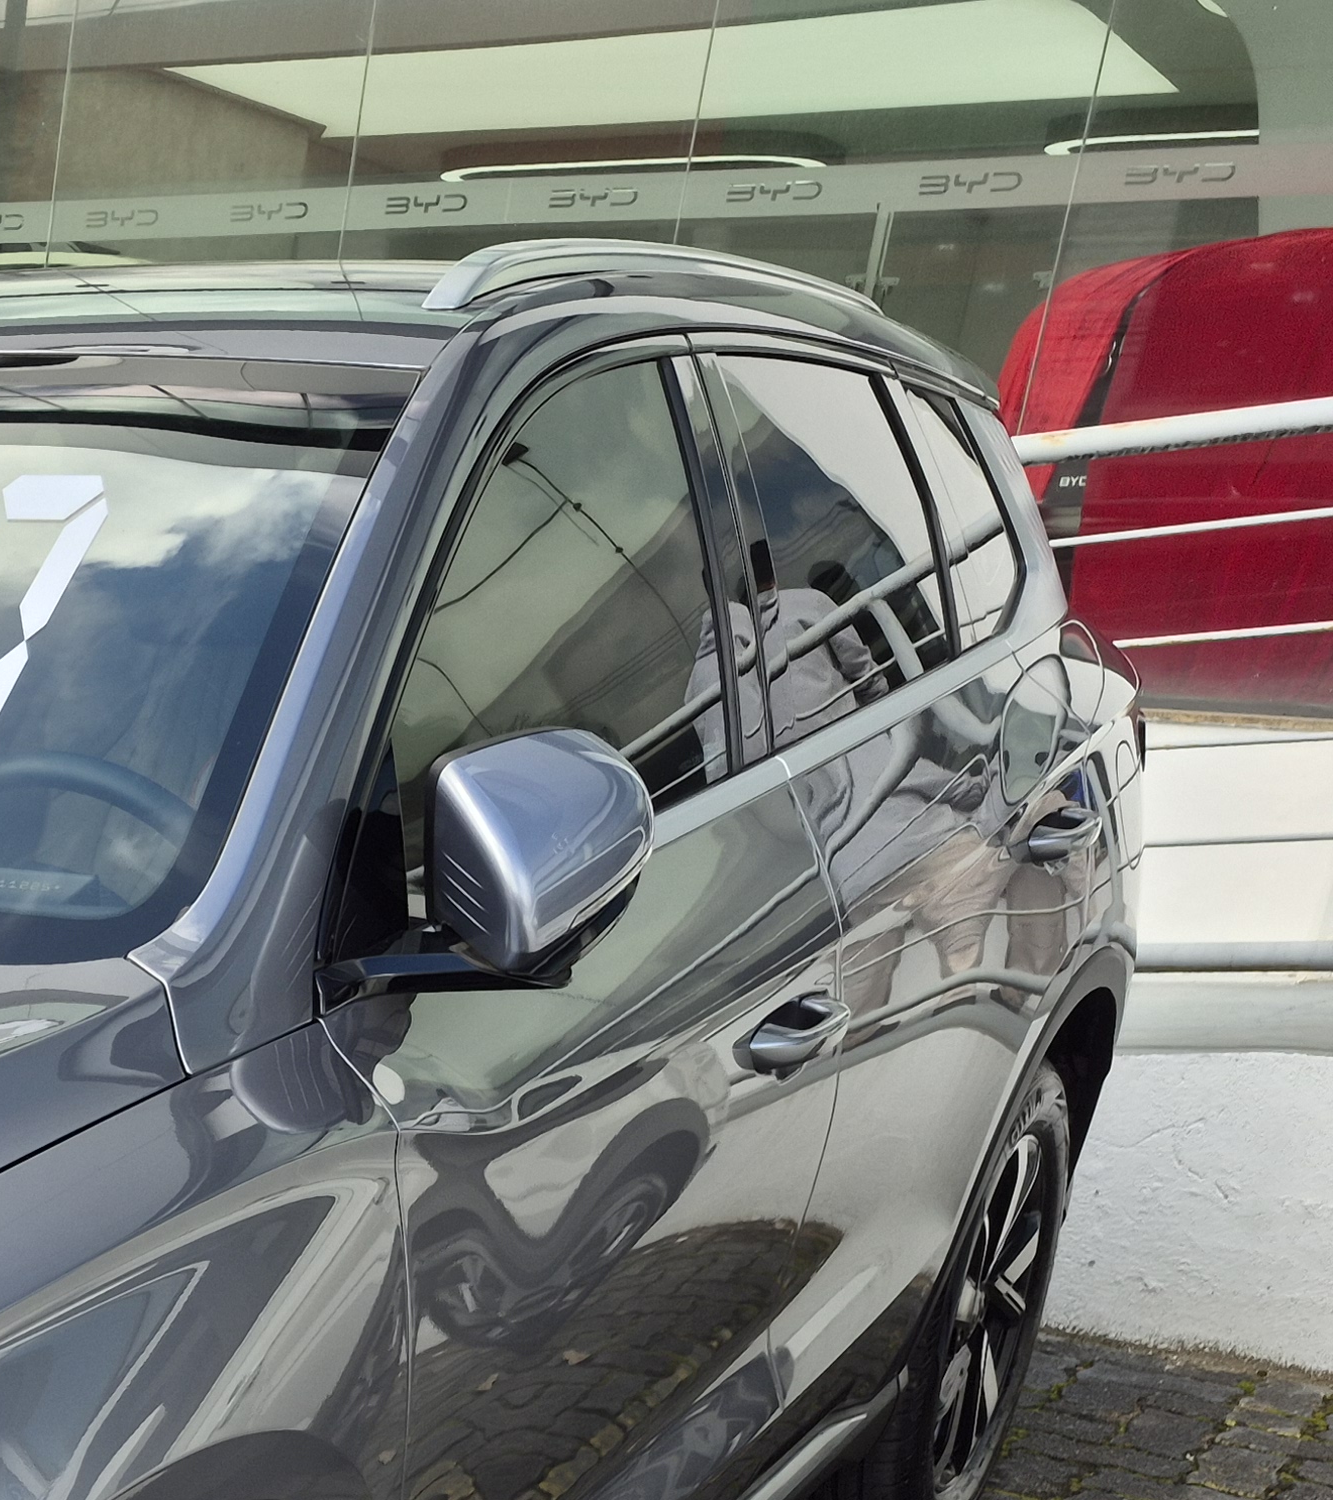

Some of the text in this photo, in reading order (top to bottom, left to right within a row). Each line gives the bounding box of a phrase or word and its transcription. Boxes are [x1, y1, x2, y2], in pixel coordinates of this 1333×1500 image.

[918, 171, 1023, 197] BYD
[1123, 162, 1236, 187] BYD
[547, 187, 639, 209] BYD
[725, 180, 824, 203] BYD
[229, 201, 309, 222] BYD
[384, 193, 468, 216] BYD
[85, 208, 159, 229] BYD
